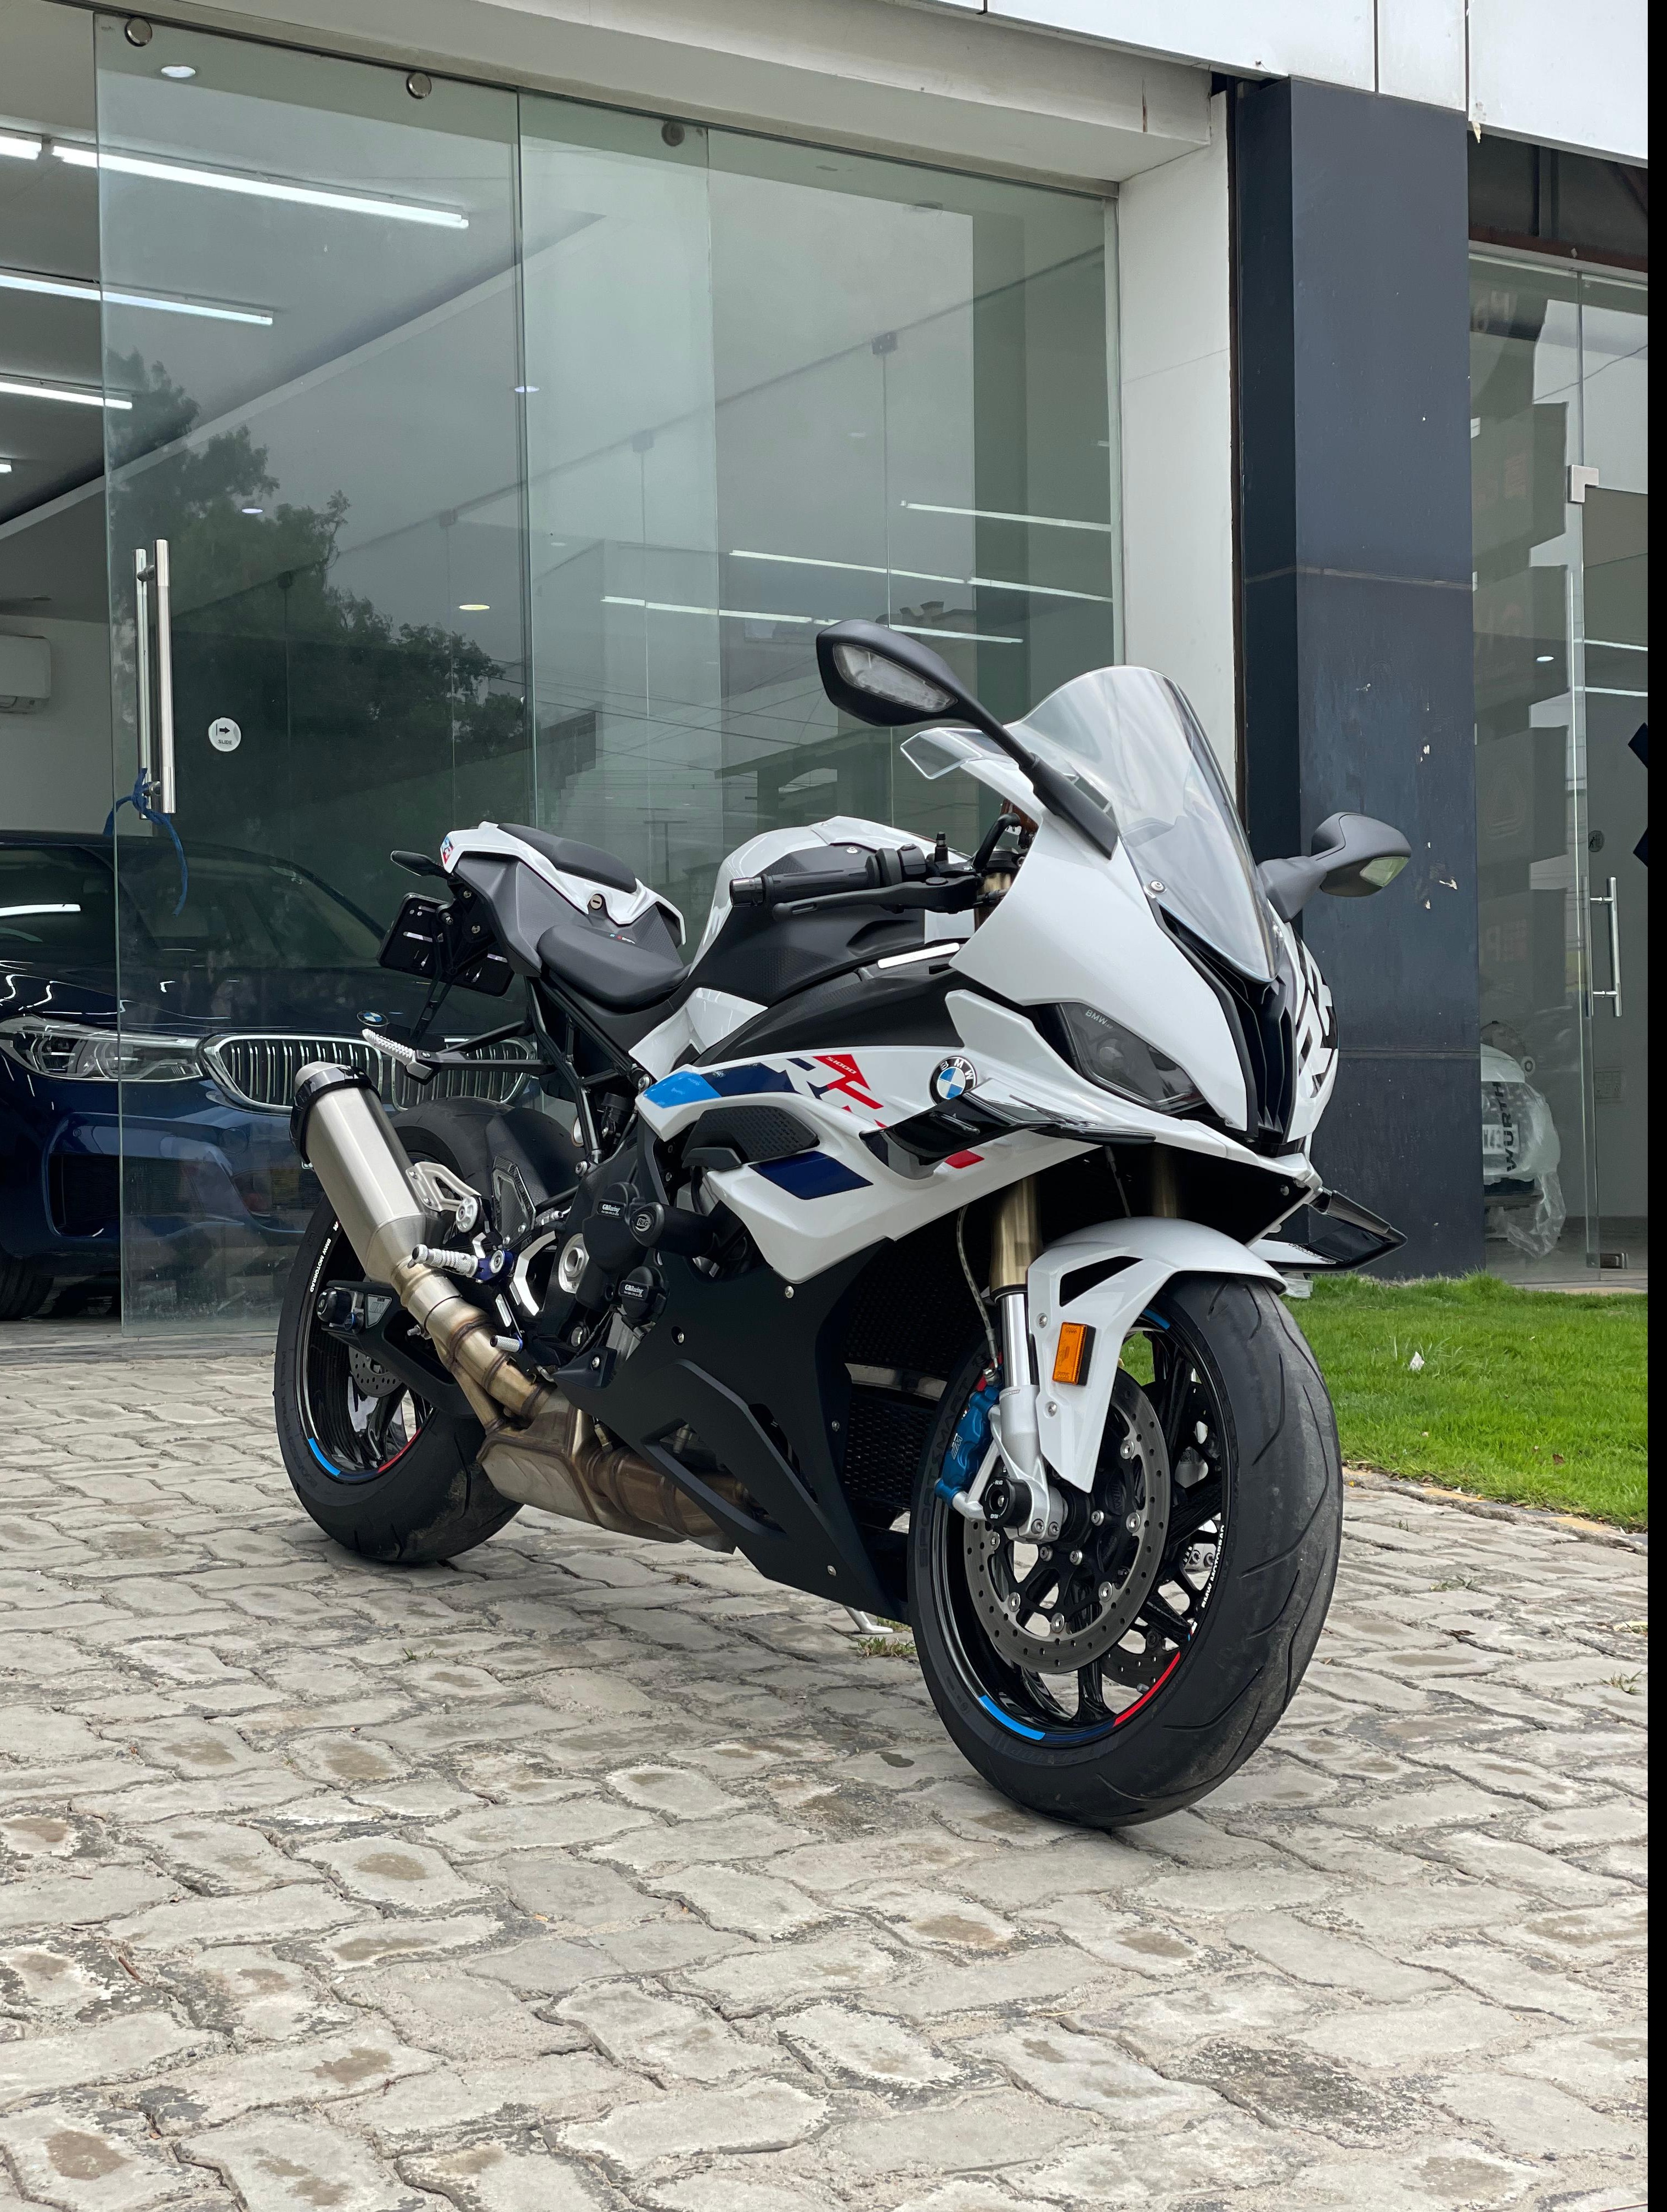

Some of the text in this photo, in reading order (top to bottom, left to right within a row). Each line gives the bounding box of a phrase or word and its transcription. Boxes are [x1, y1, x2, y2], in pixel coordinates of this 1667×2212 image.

[1085, 1009, 1108, 1025] BMW
[826, 1056, 857, 1075] S1000
[310, 1255, 325, 1293] MOTORRAD
